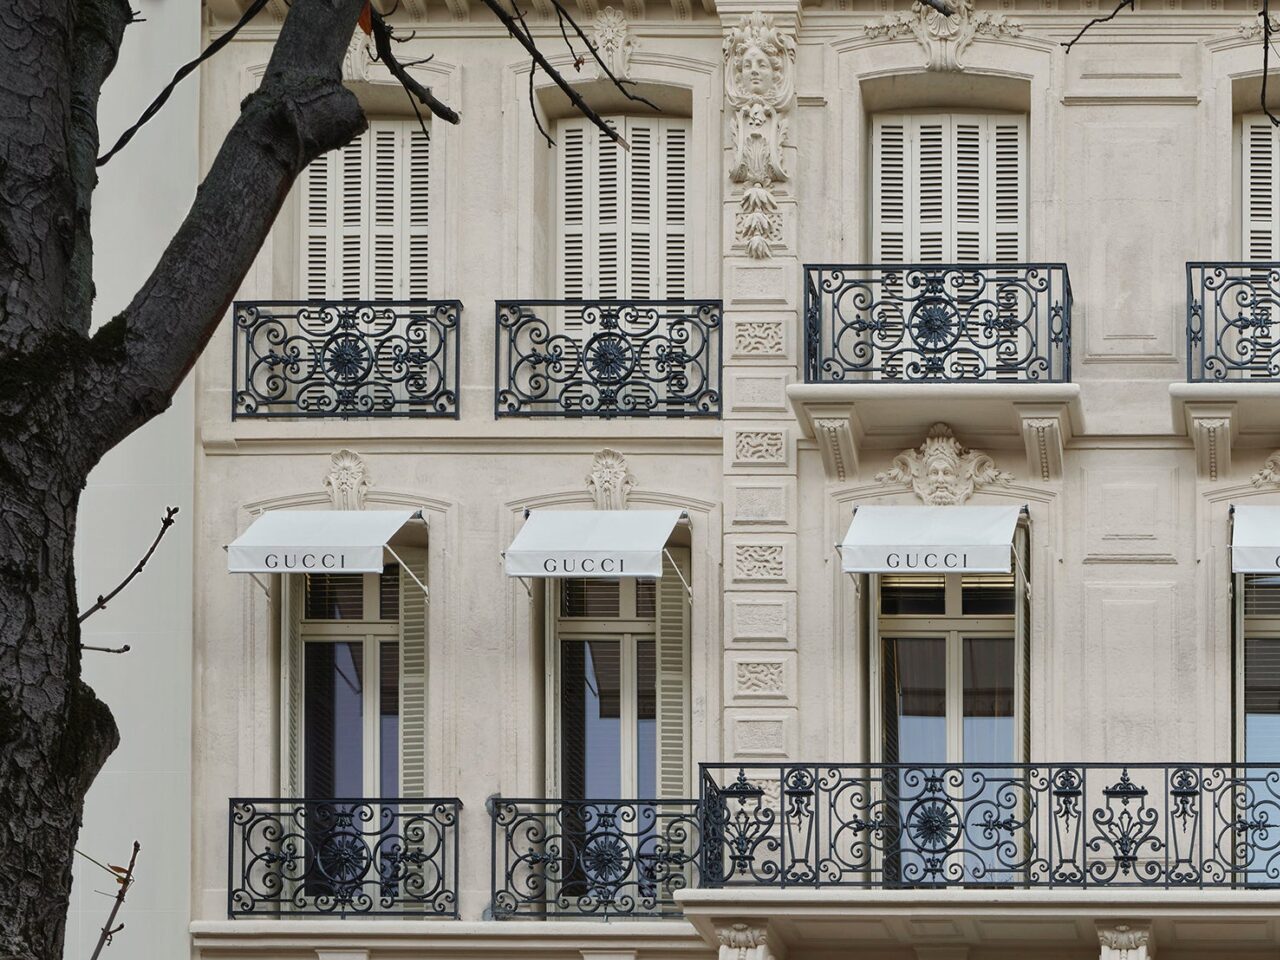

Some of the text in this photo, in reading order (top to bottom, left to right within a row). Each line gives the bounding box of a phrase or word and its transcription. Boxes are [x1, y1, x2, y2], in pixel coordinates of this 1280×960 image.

[265, 553, 347, 569] GUCCI
[543, 558, 626, 573] GUCCI
[886, 553, 967, 568] GUCCI
